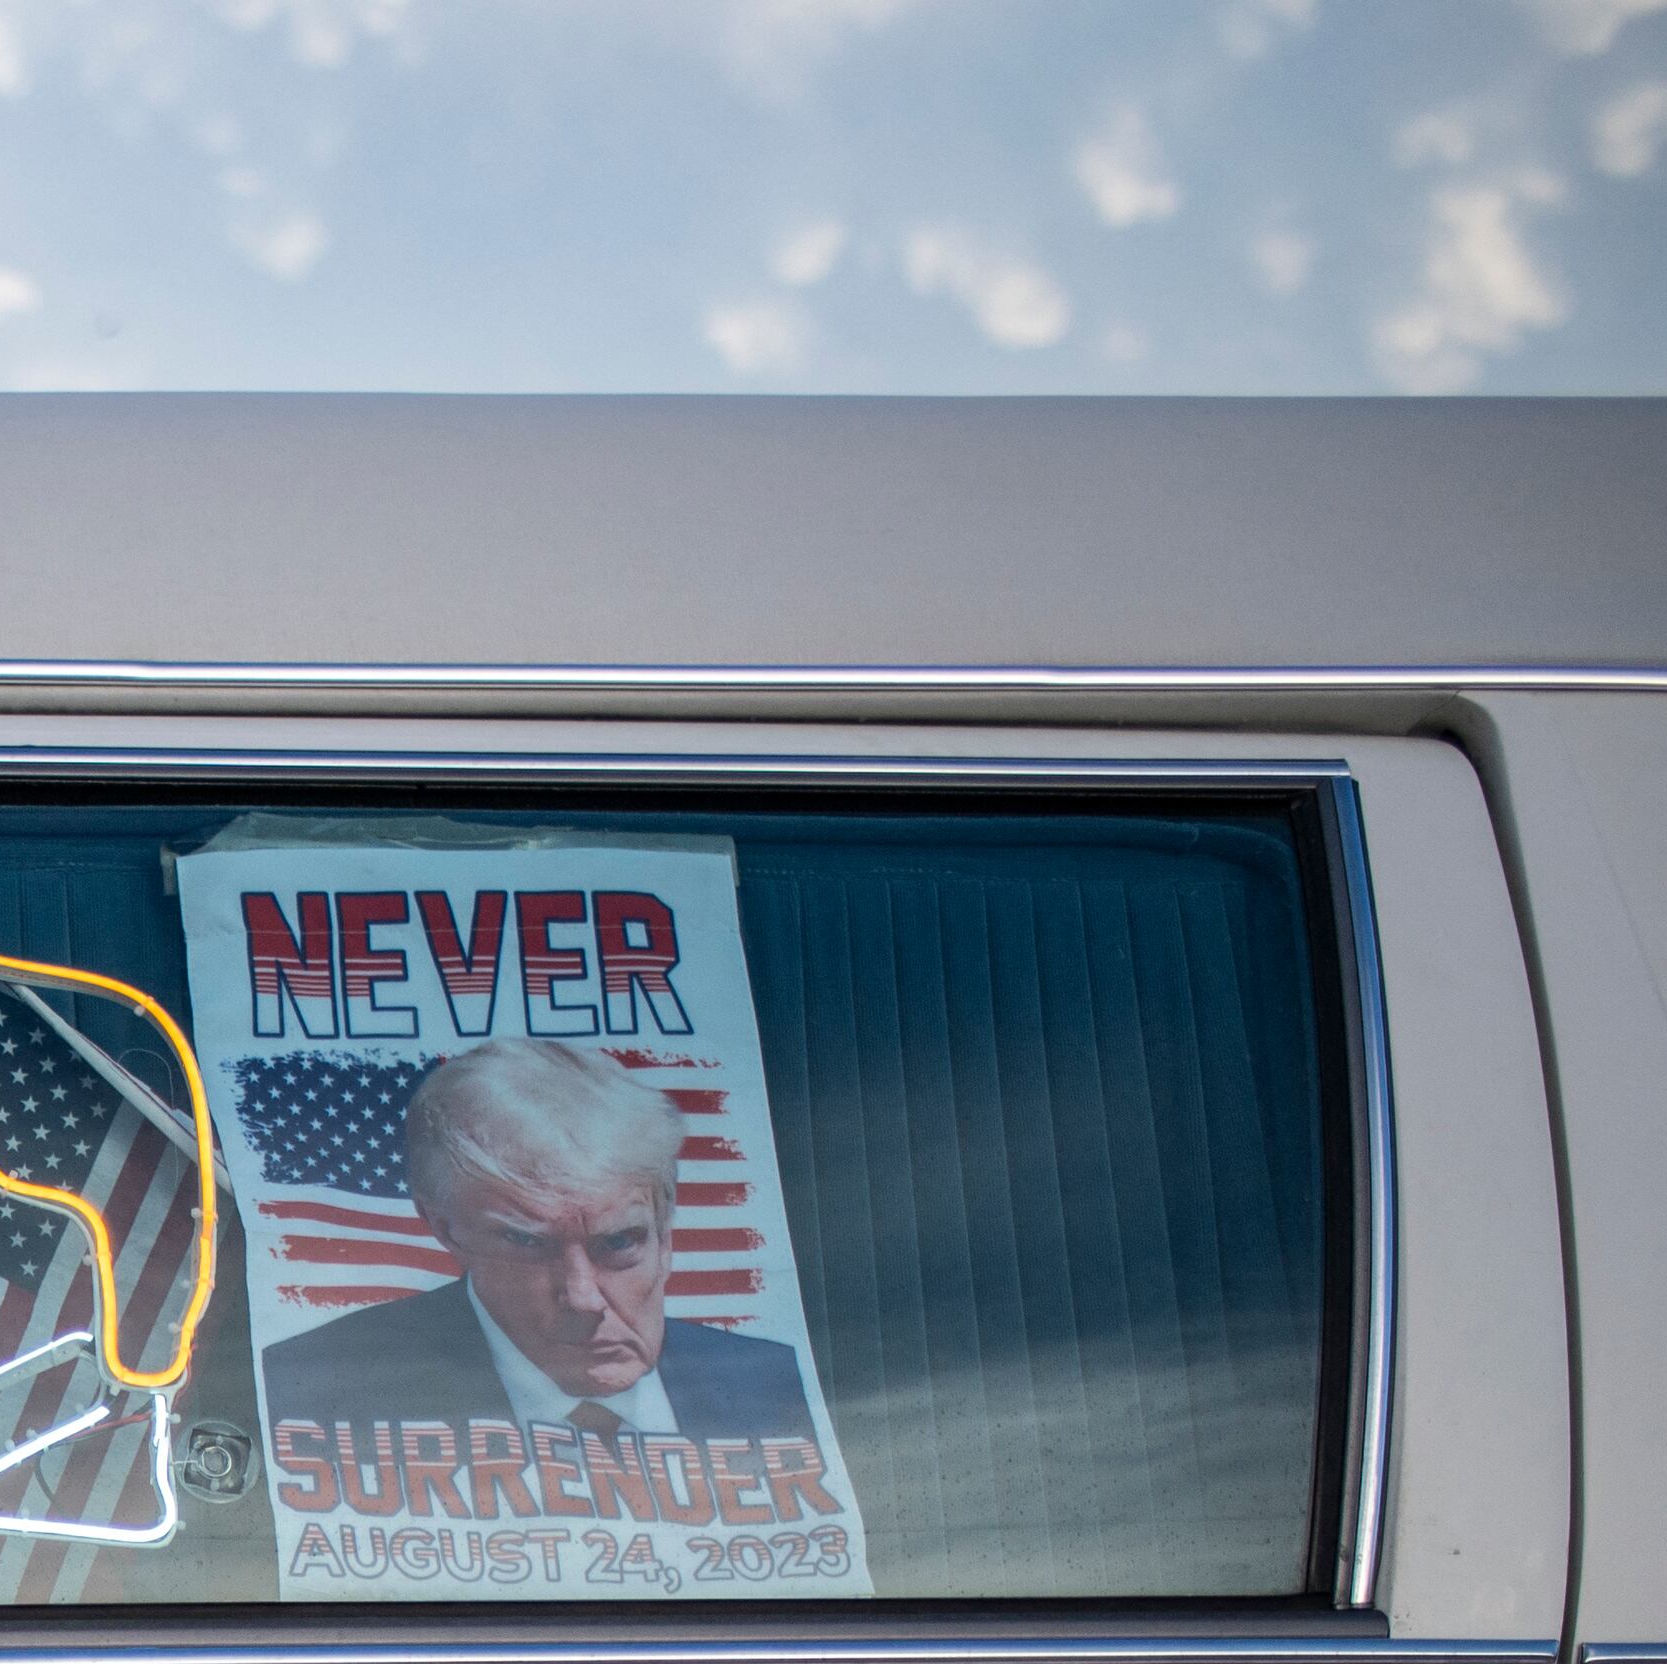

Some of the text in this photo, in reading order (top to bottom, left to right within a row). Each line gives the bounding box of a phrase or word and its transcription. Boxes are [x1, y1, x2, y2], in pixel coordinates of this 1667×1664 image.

[240, 890, 695, 1039] NEVER
[273, 1417, 844, 1528] SURRENDER
[289, 1522, 853, 1594] AUGUST 24, 2023
